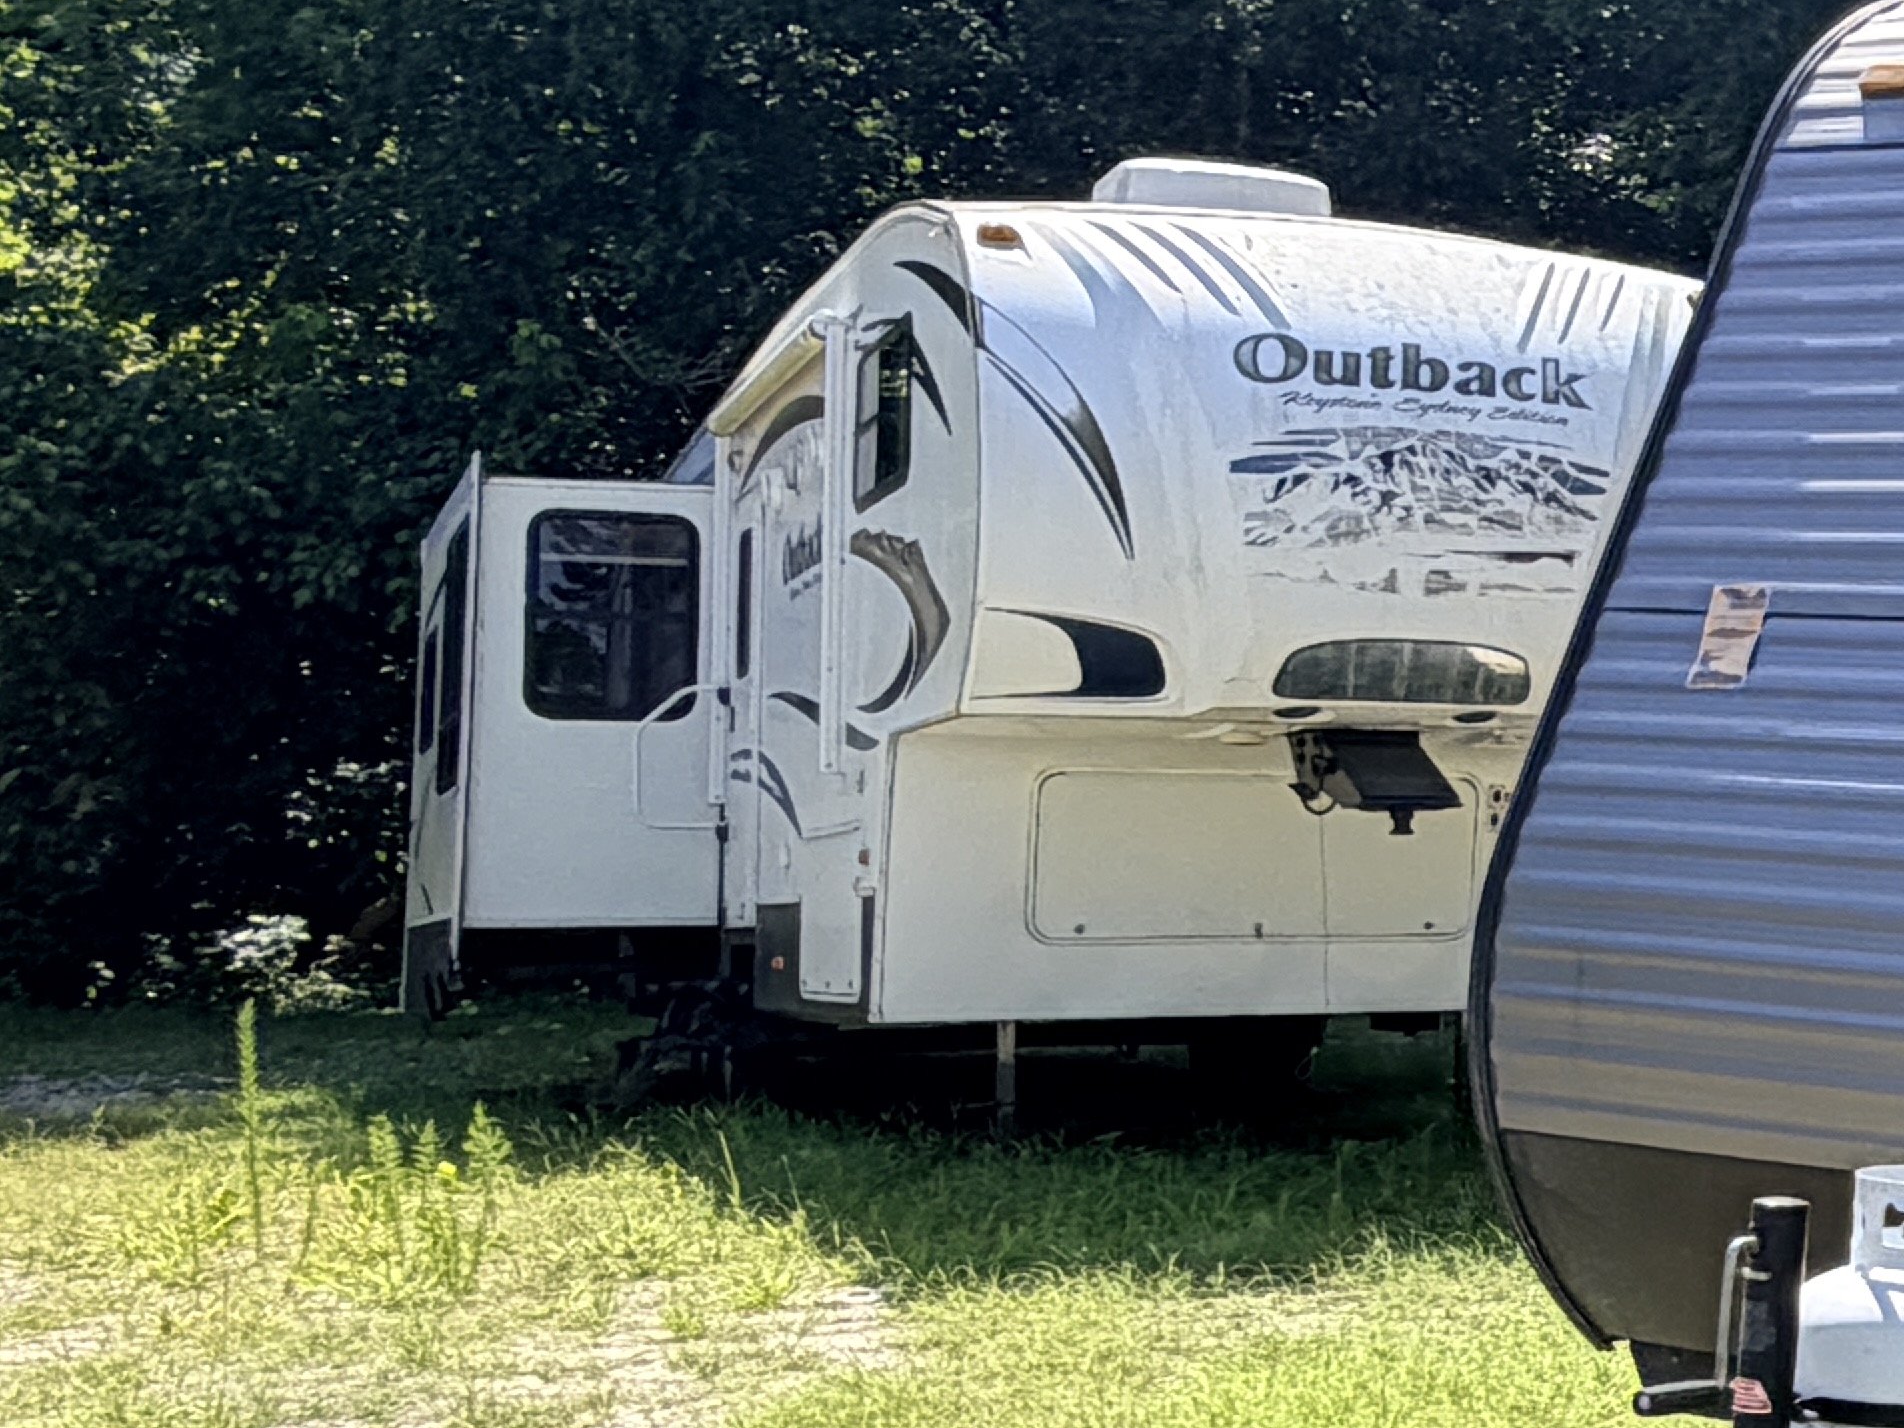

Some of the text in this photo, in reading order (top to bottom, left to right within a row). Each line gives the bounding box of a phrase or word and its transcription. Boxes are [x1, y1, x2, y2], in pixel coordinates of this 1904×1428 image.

[1232, 332, 1594, 411] Outback
[1392, 396, 1482, 422] Sydney
[1486, 406, 1569, 427] Edition
